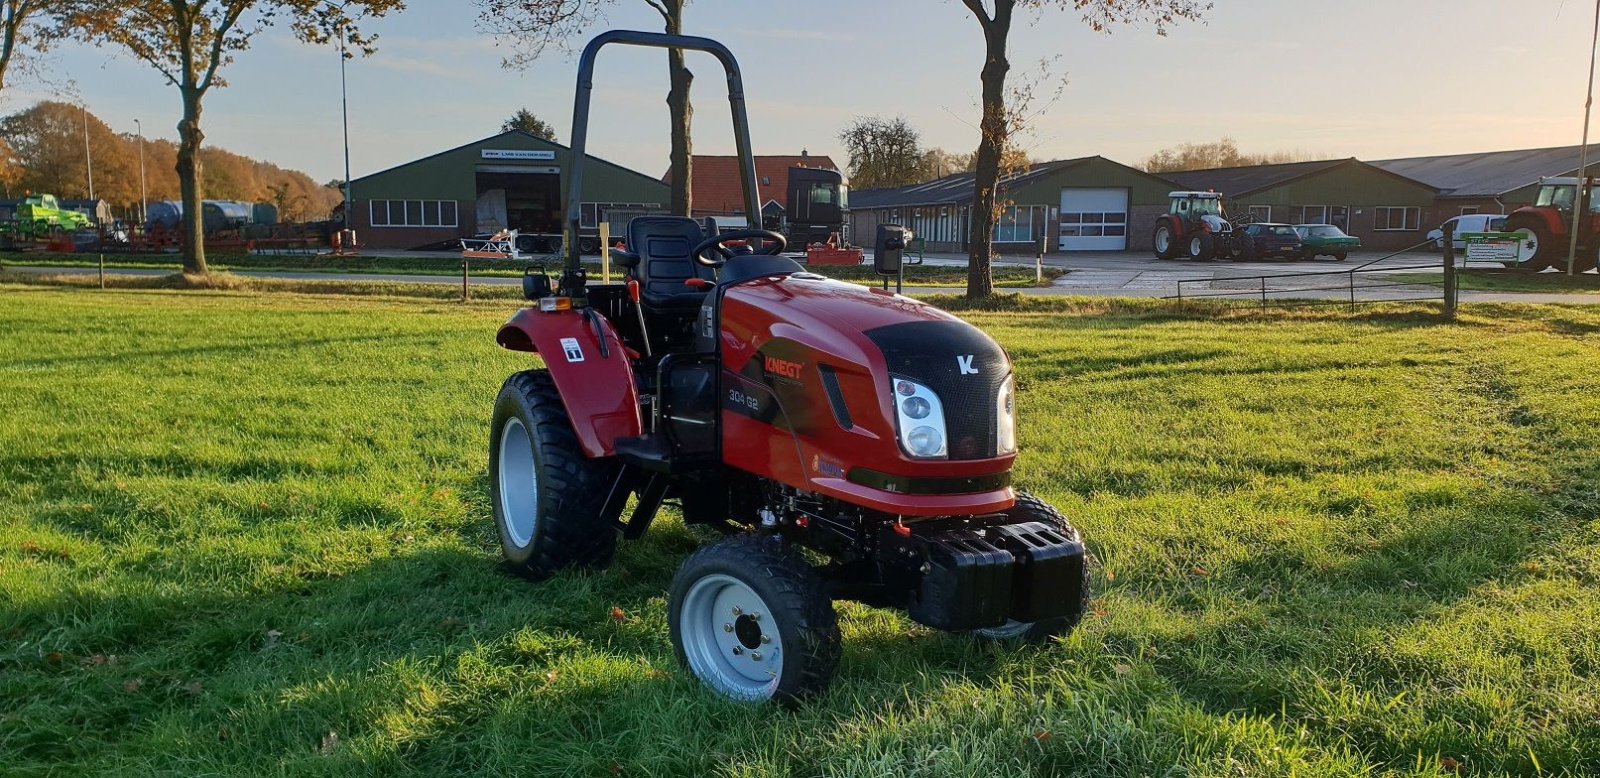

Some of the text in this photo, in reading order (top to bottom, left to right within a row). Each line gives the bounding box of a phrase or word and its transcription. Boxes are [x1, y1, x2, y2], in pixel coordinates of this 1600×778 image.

[765, 356, 802, 379] KNEGT
[957, 355, 979, 375] K
[729, 389, 759, 411] 304 G2
